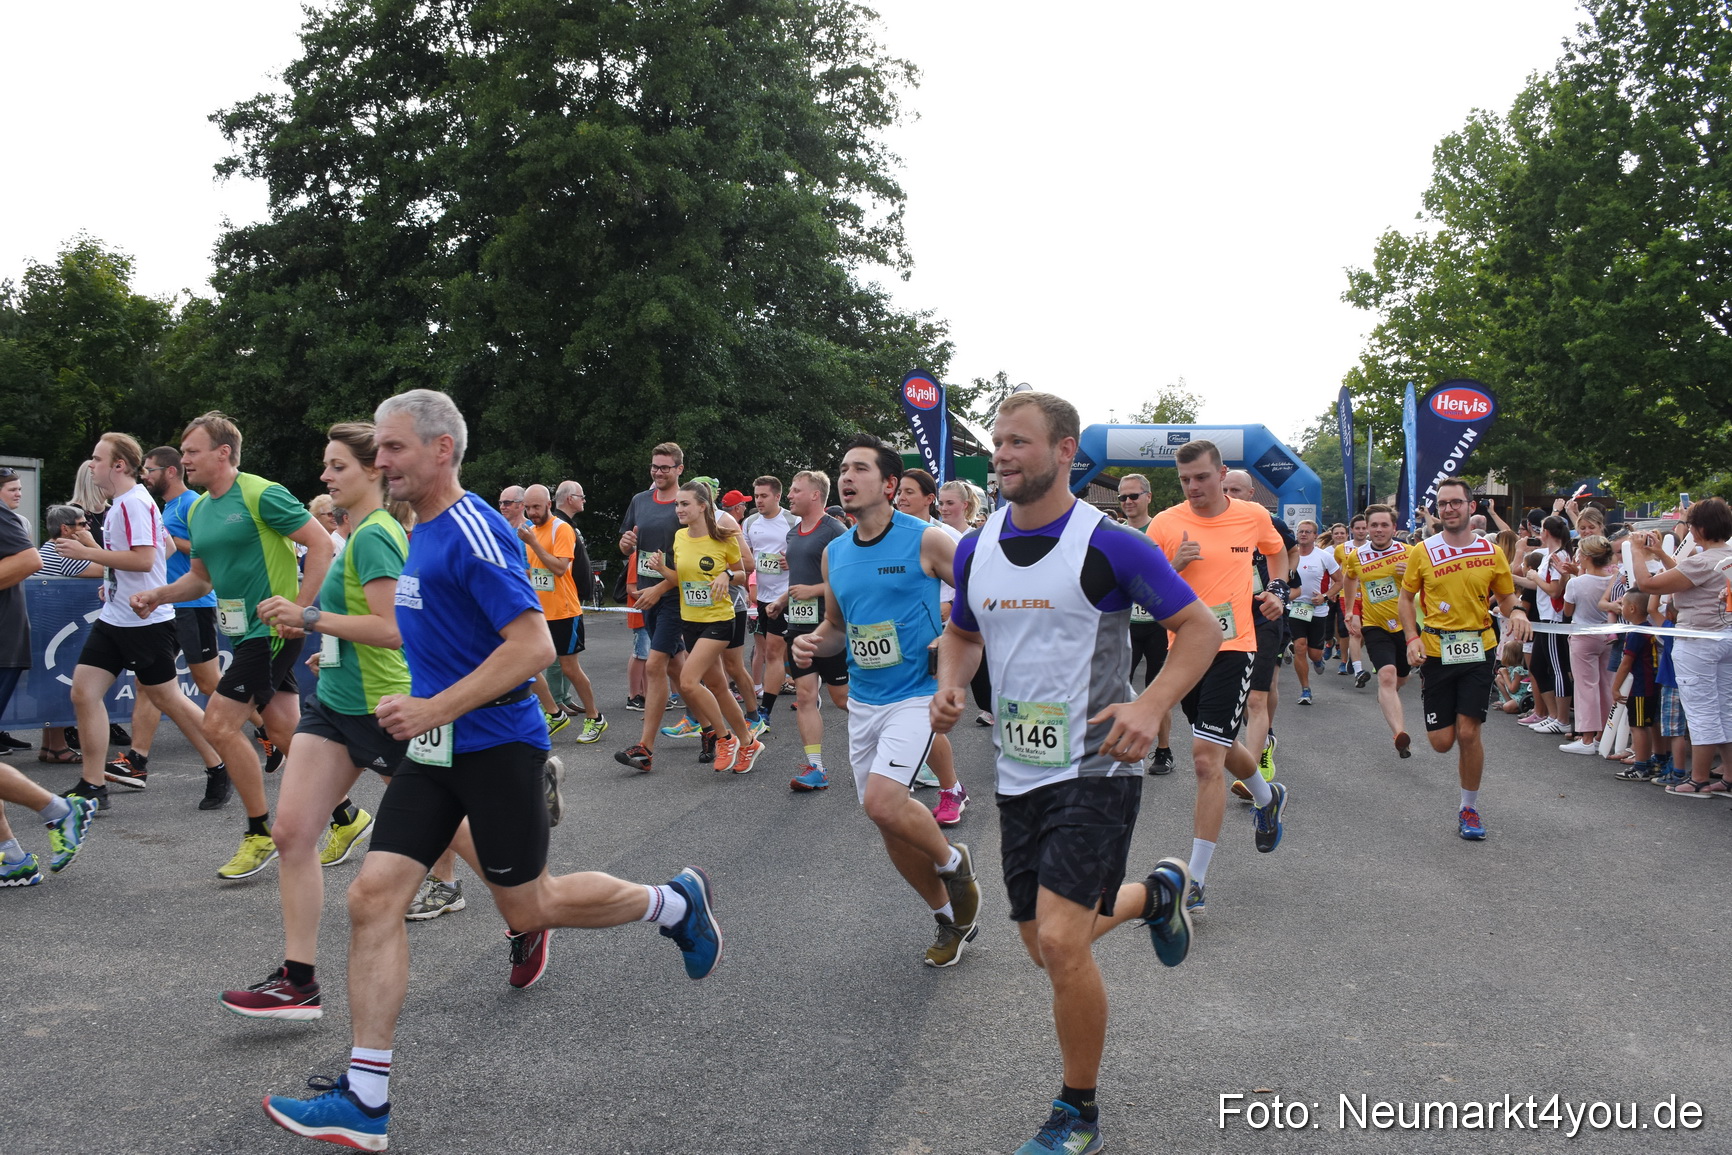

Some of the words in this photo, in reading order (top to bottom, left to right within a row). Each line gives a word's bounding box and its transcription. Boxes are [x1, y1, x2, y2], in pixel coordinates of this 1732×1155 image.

[1436, 394, 1488, 415] Hervis
[760, 560, 779, 569] 1472
[877, 565, 906, 575] THULE
[1362, 562, 1383, 574] MAX
[1386, 554, 1409, 566] BÖGL
[1433, 563, 1462, 578] MAX
[1465, 558, 1495, 569] BÖGL
[534, 576, 548, 585] 112
[685, 590, 708, 600] 1763
[1370, 584, 1393, 598] 1652
[1001, 599, 1055, 609] KLEBL
[791, 606, 814, 616] 1493
[1295, 607, 1309, 616] 358
[851, 638, 891, 657] 2300
[1446, 642, 1479, 656] 1685
[1426, 712, 1438, 725] 42
[1201, 721, 1224, 734] hummel
[1005, 722, 1057, 749] 1146
